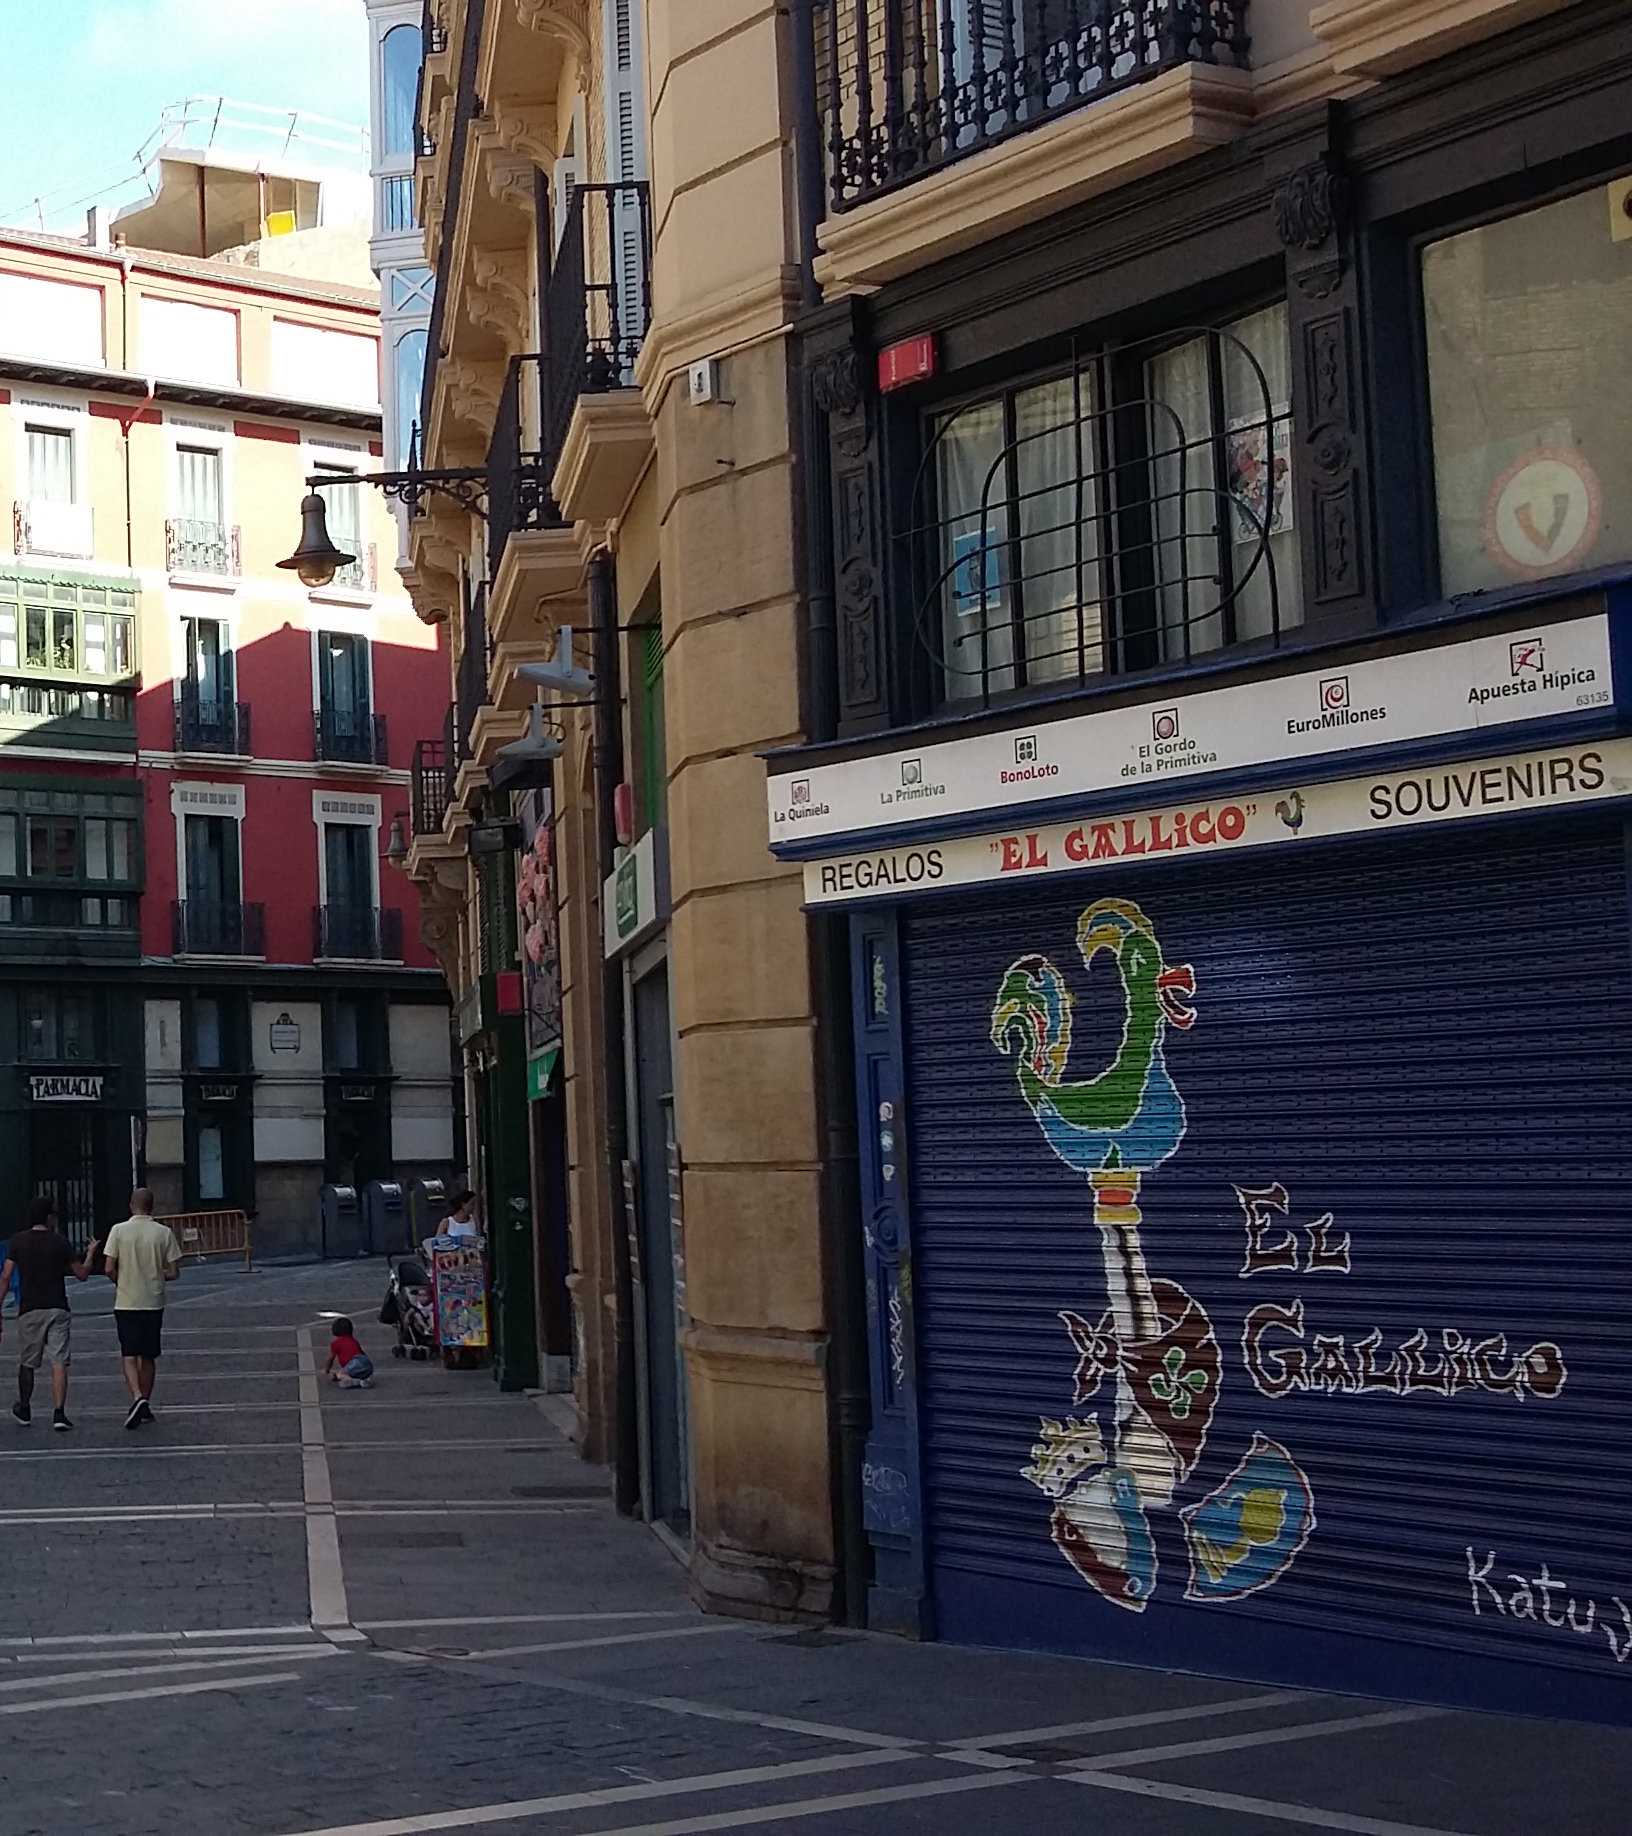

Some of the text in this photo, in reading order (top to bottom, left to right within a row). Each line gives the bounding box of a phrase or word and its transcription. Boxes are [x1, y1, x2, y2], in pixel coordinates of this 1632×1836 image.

[1468, 668, 1596, 704] Apuesta Hípica
[1576, 691, 1609, 706] 63135
[1287, 706, 1387, 734] EuroMillones
[1139, 738, 1196, 758] El Gordo
[1000, 763, 1059, 784] BonoLoto
[1121, 751, 1217, 777] de la Primitiva
[880, 783, 946, 804] La Primitiva
[774, 803, 830, 823] La Quiniela
[821, 849, 944, 893] REGALOS
[1369, 752, 1605, 820] SOUVENIRS
[35, 1077, 99, 1099] FARMACIA
